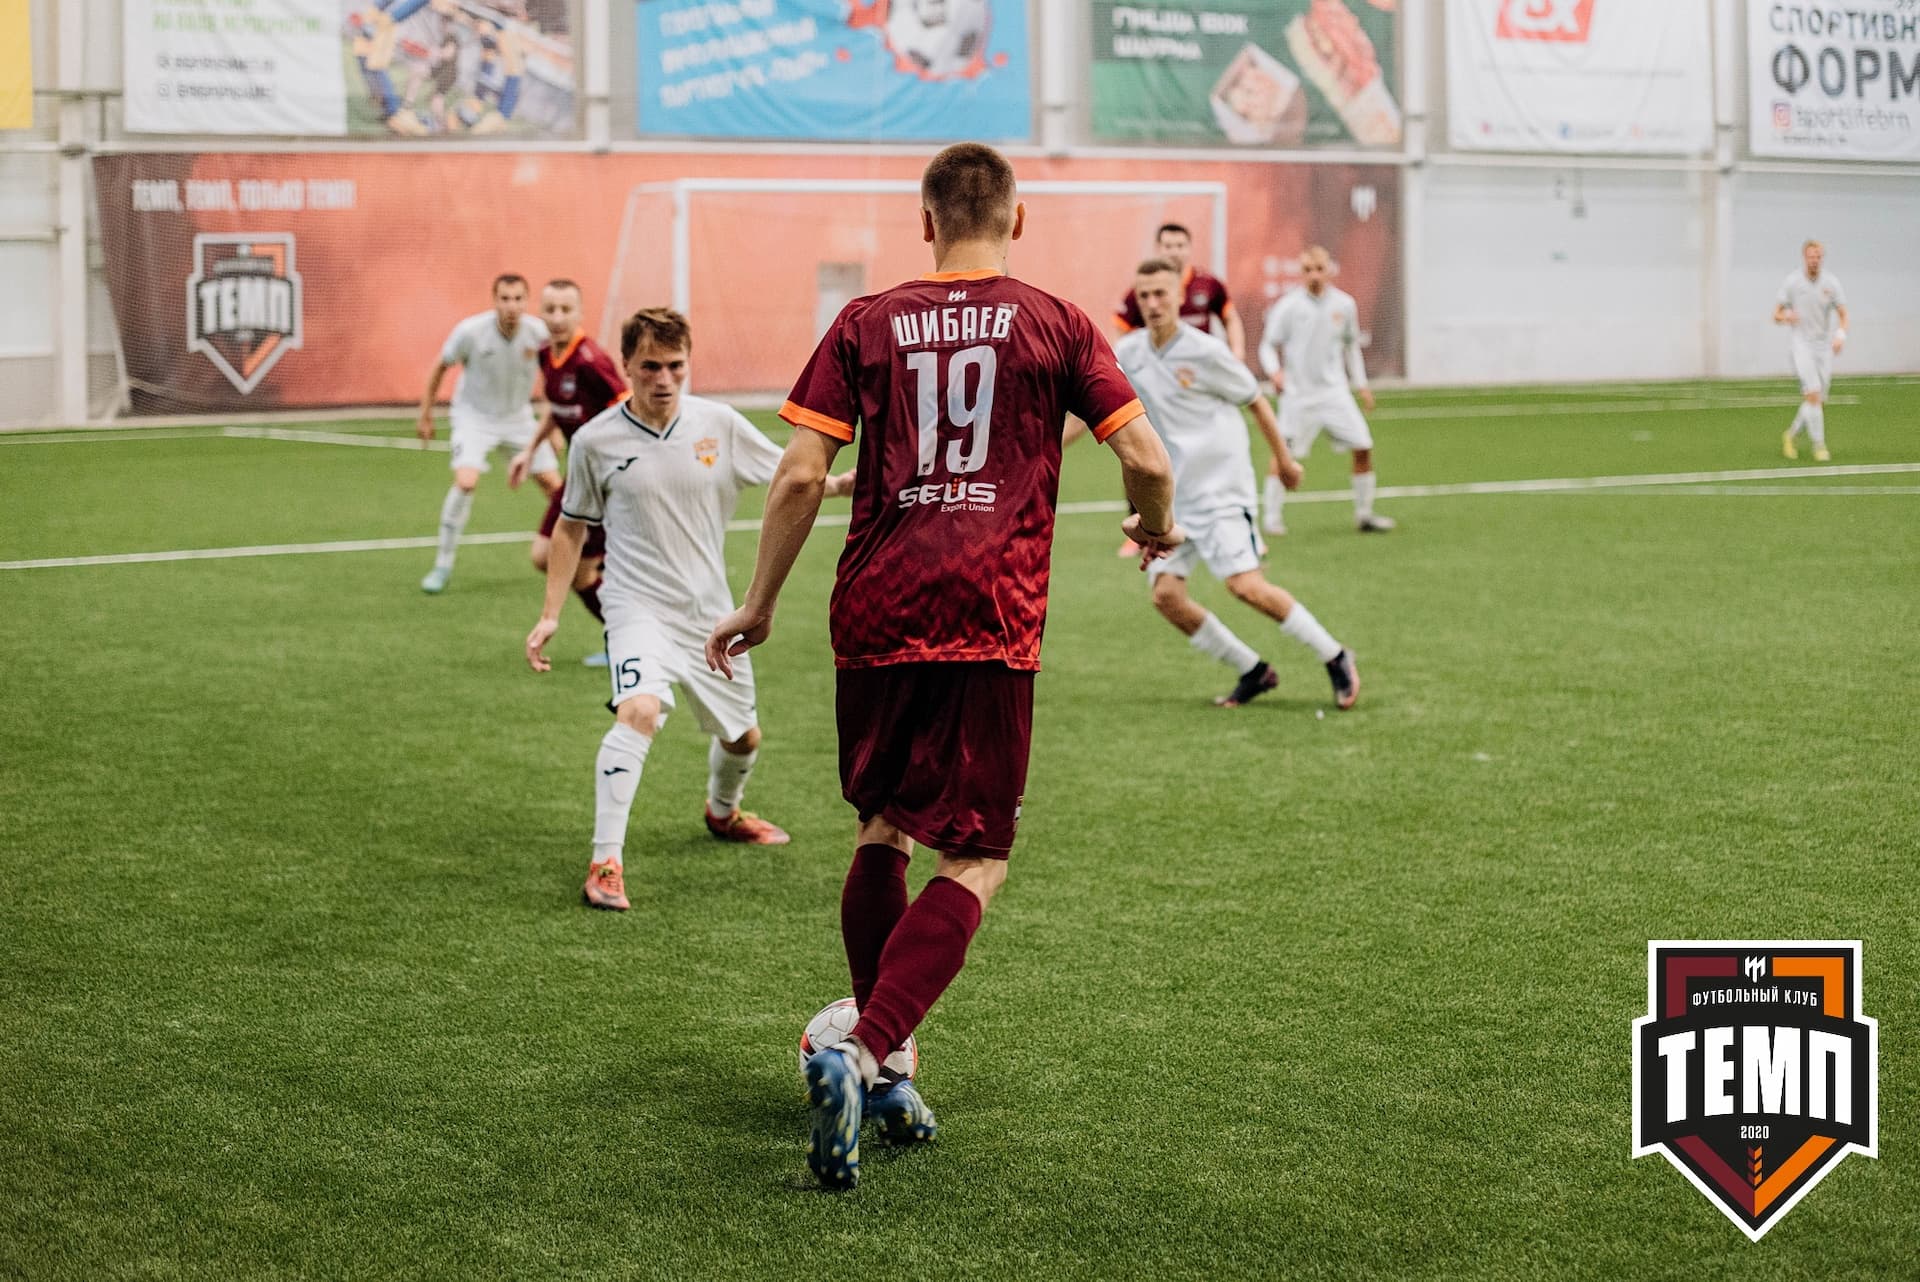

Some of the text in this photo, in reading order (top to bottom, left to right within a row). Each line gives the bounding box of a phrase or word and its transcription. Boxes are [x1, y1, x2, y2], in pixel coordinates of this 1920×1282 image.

[1771, 5, 1920, 41] СПОРТИВН
[201, 277, 293, 335] ТЕМП
[893, 306, 1014, 348] ШИБАЕВ
[906, 345, 997, 477] 19
[940, 503, 995, 513] Export Union
[615, 658, 641, 694] 15
